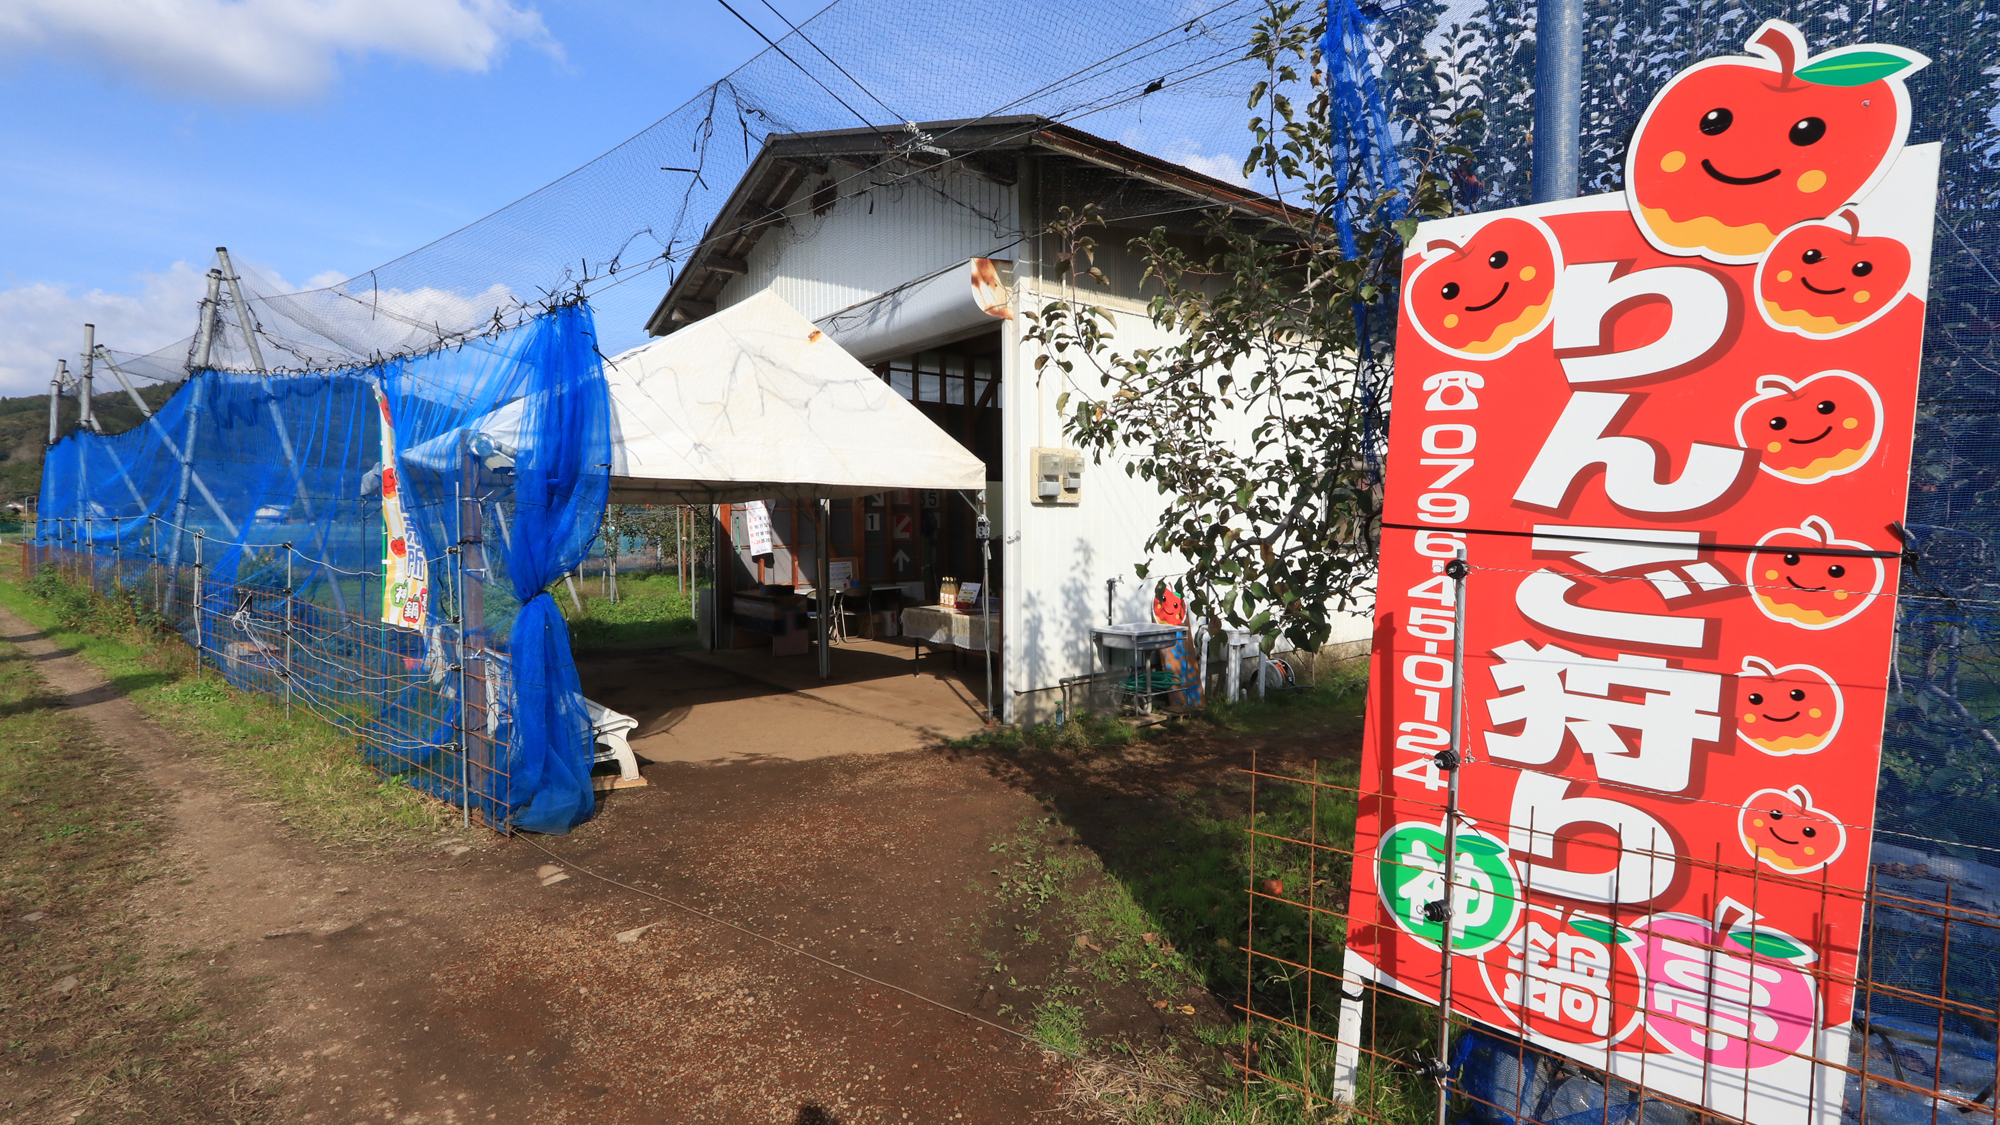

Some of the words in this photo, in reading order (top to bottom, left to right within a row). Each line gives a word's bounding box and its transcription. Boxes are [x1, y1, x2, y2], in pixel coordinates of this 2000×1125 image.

[1482, 260, 1748, 905] りんご狩り
